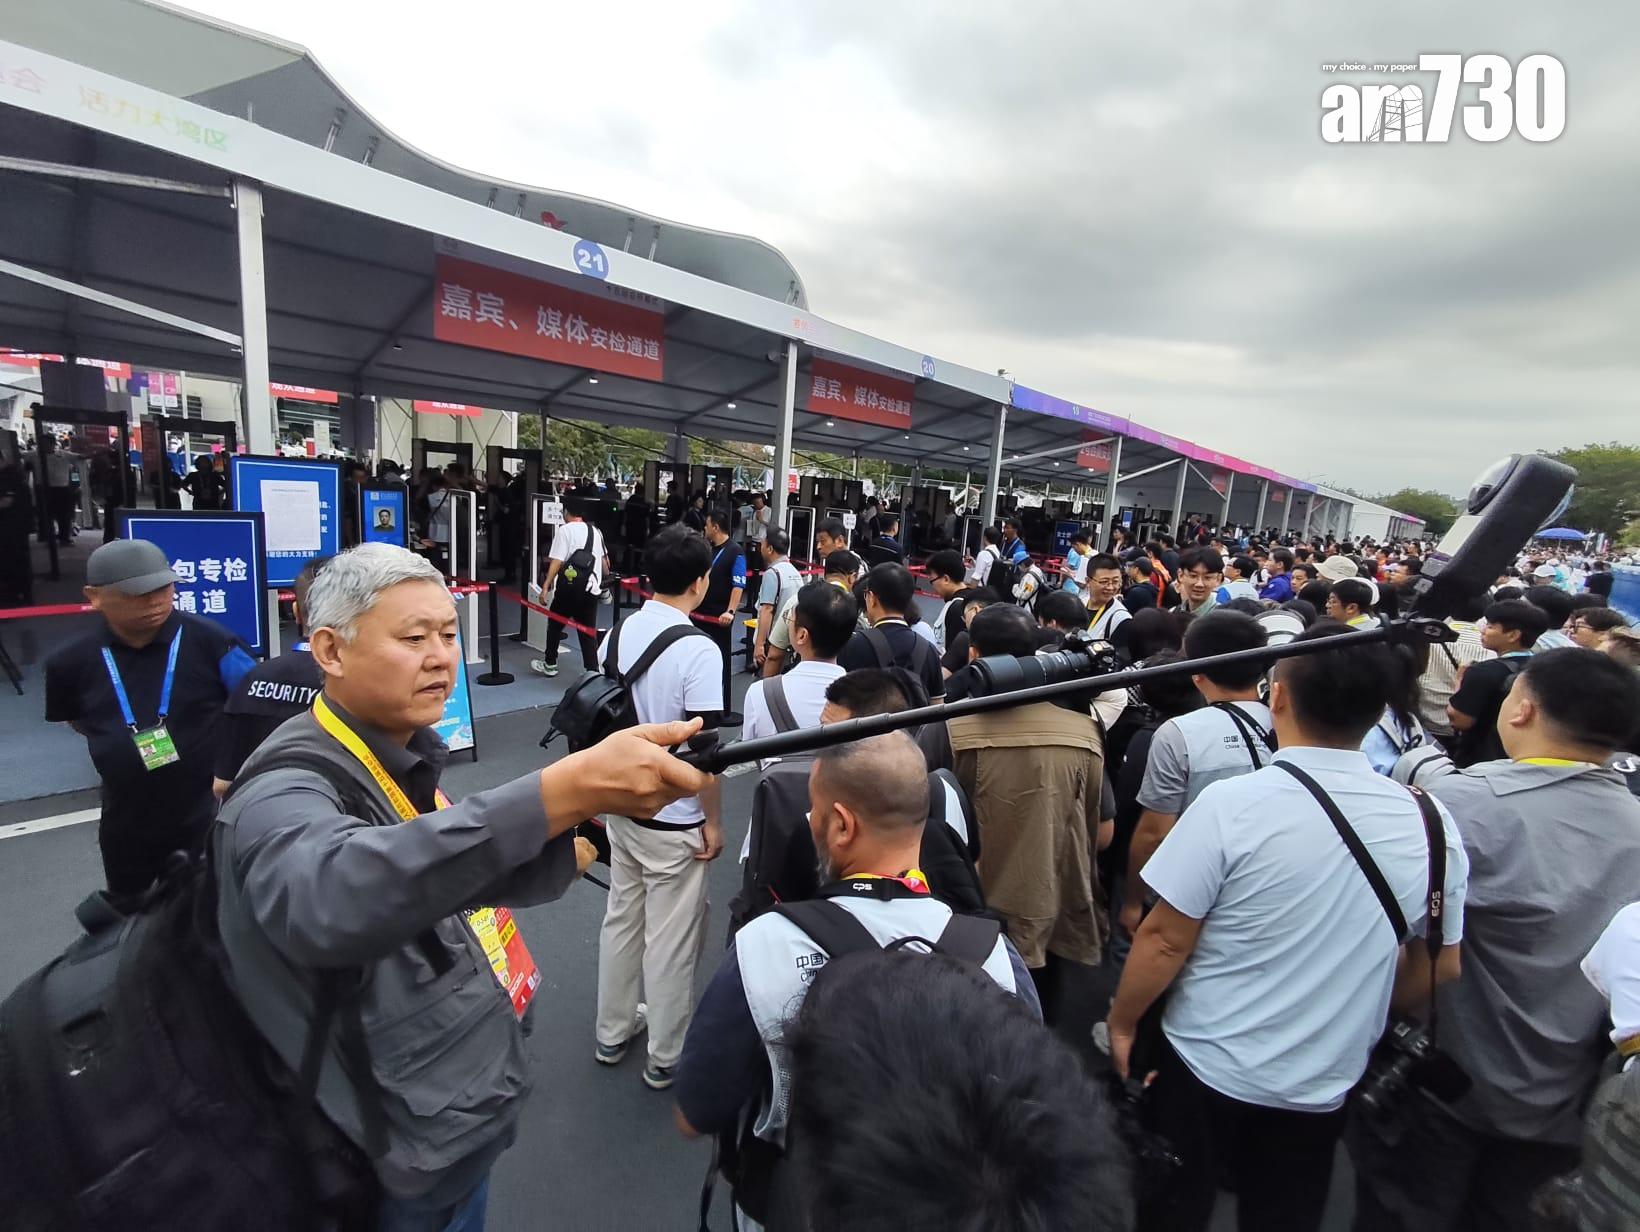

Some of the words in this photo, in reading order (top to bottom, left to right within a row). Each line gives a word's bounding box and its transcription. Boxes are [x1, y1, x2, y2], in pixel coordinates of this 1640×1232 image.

[577, 248, 604, 272] 21
[922, 362, 934, 375] 20
[248, 680, 318, 704] SECURITY
[1431, 891, 1441, 917] EOS
[796, 952, 824, 969] 中国
